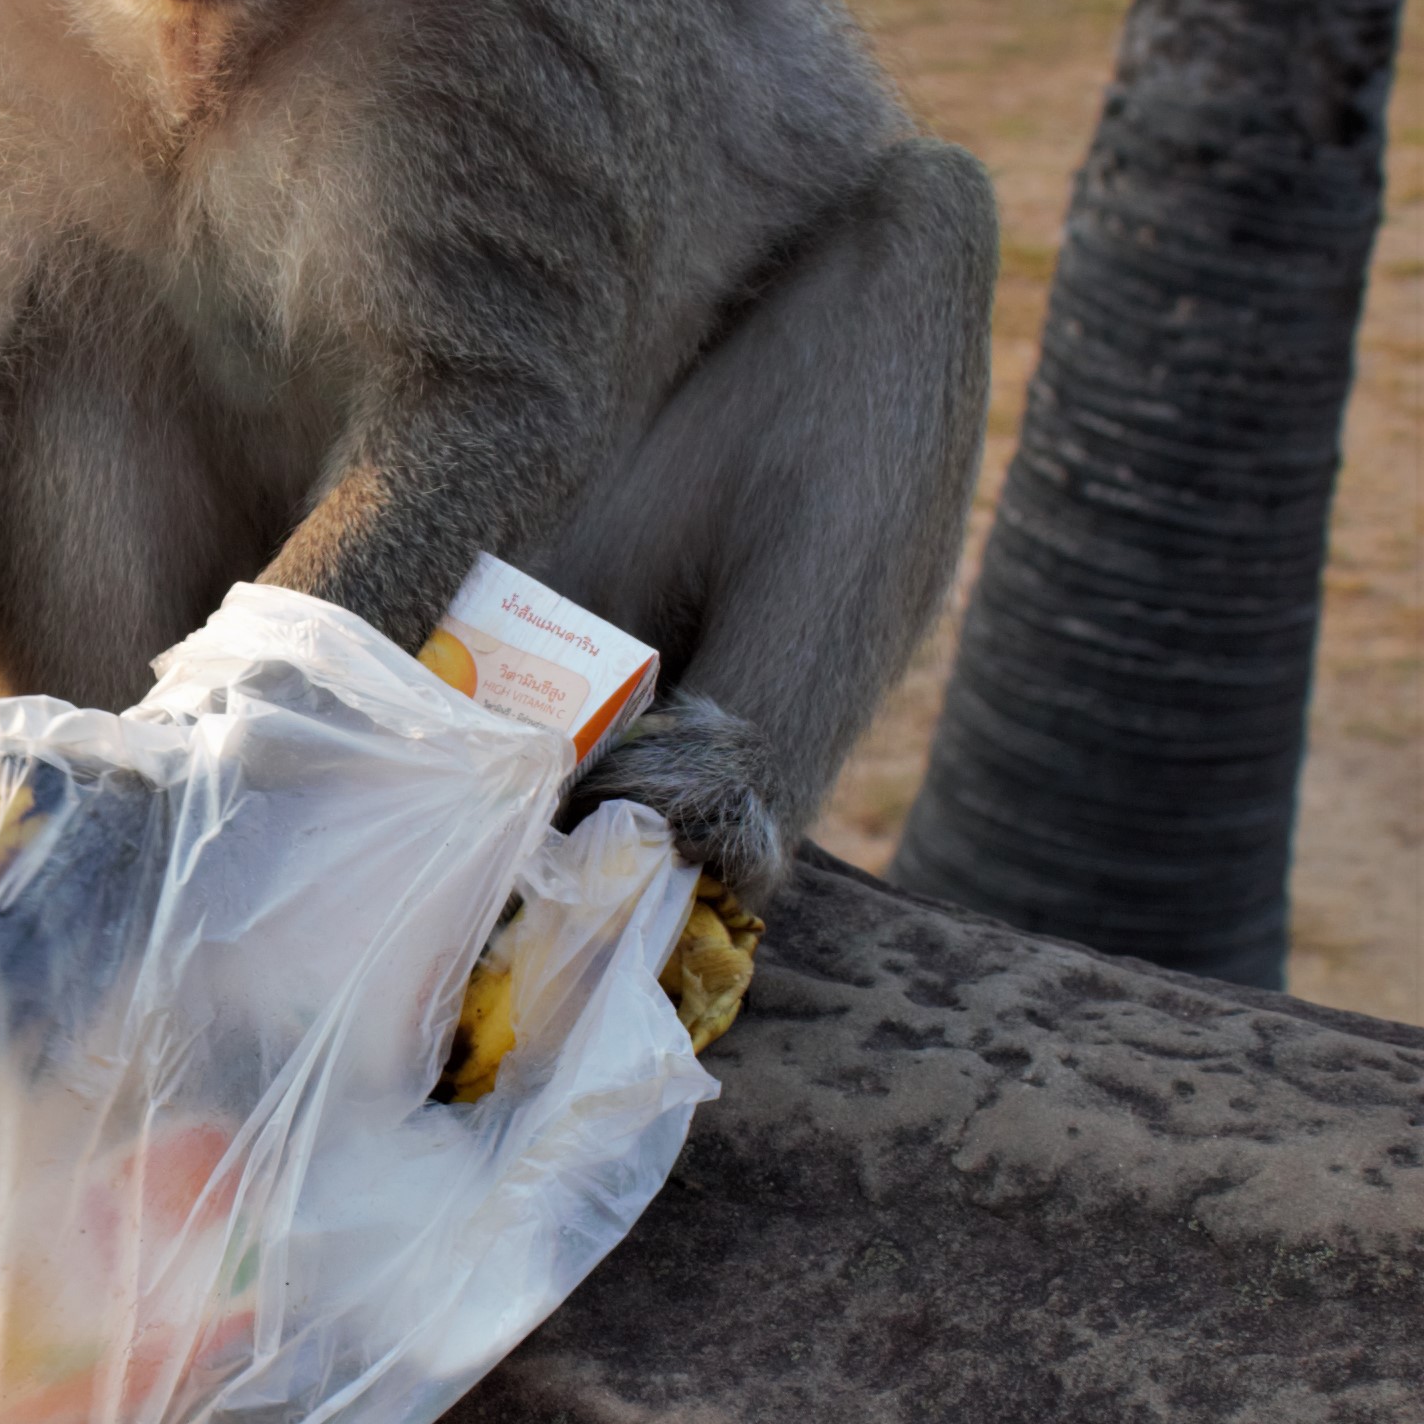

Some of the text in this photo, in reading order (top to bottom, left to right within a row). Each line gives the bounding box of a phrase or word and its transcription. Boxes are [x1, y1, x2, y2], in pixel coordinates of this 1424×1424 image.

[501, 596, 600, 656] น้ำส้มแมนดาริน
[483, 680, 566, 719] HIGH VITAMIN C
[499, 664, 566, 702] วิตามินซีสูง
